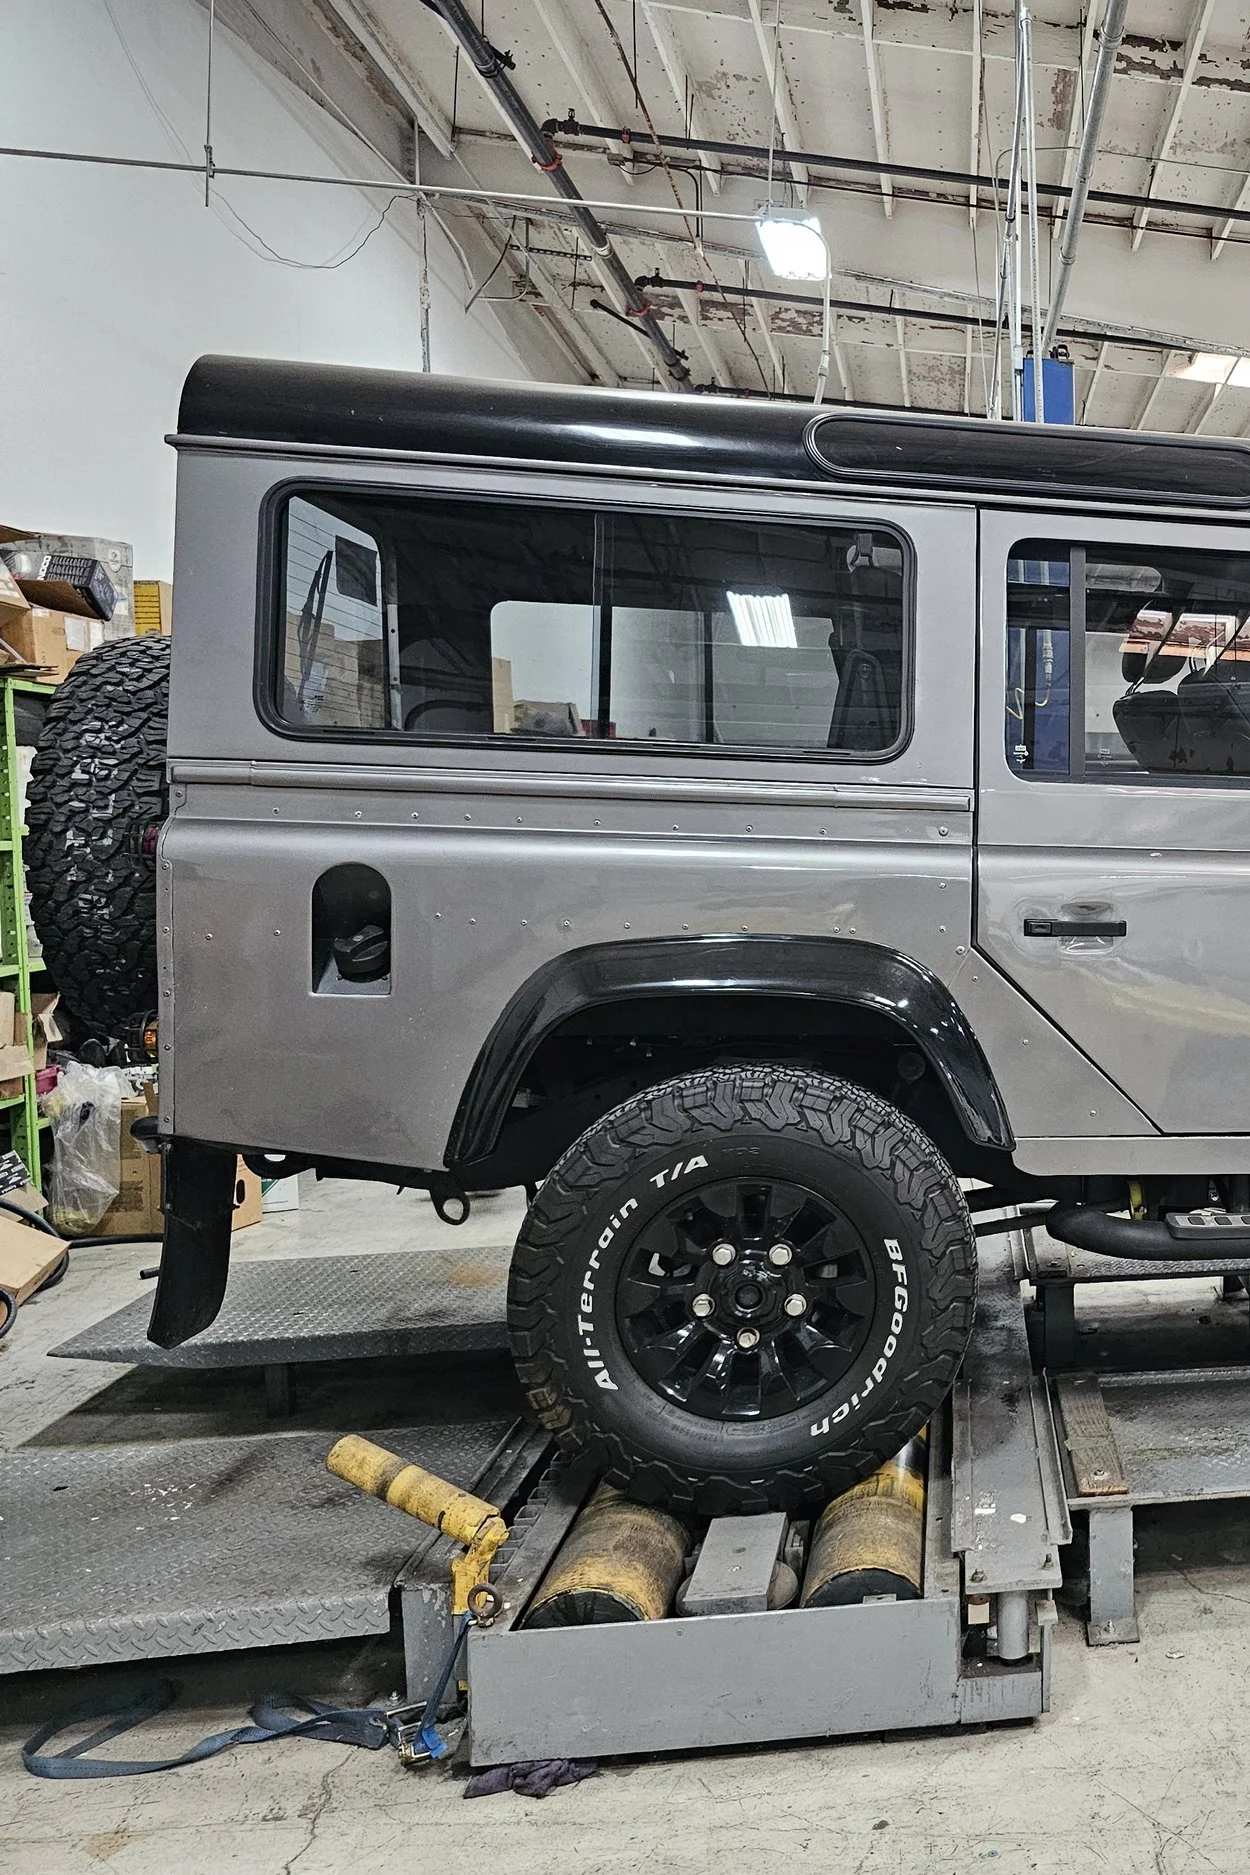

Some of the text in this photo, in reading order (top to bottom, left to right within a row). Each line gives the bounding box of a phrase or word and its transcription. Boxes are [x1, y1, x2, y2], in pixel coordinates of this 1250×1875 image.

[578, 1155, 709, 1391] All-Terrain T/A
[810, 1238, 911, 1437] BFGoodrich
